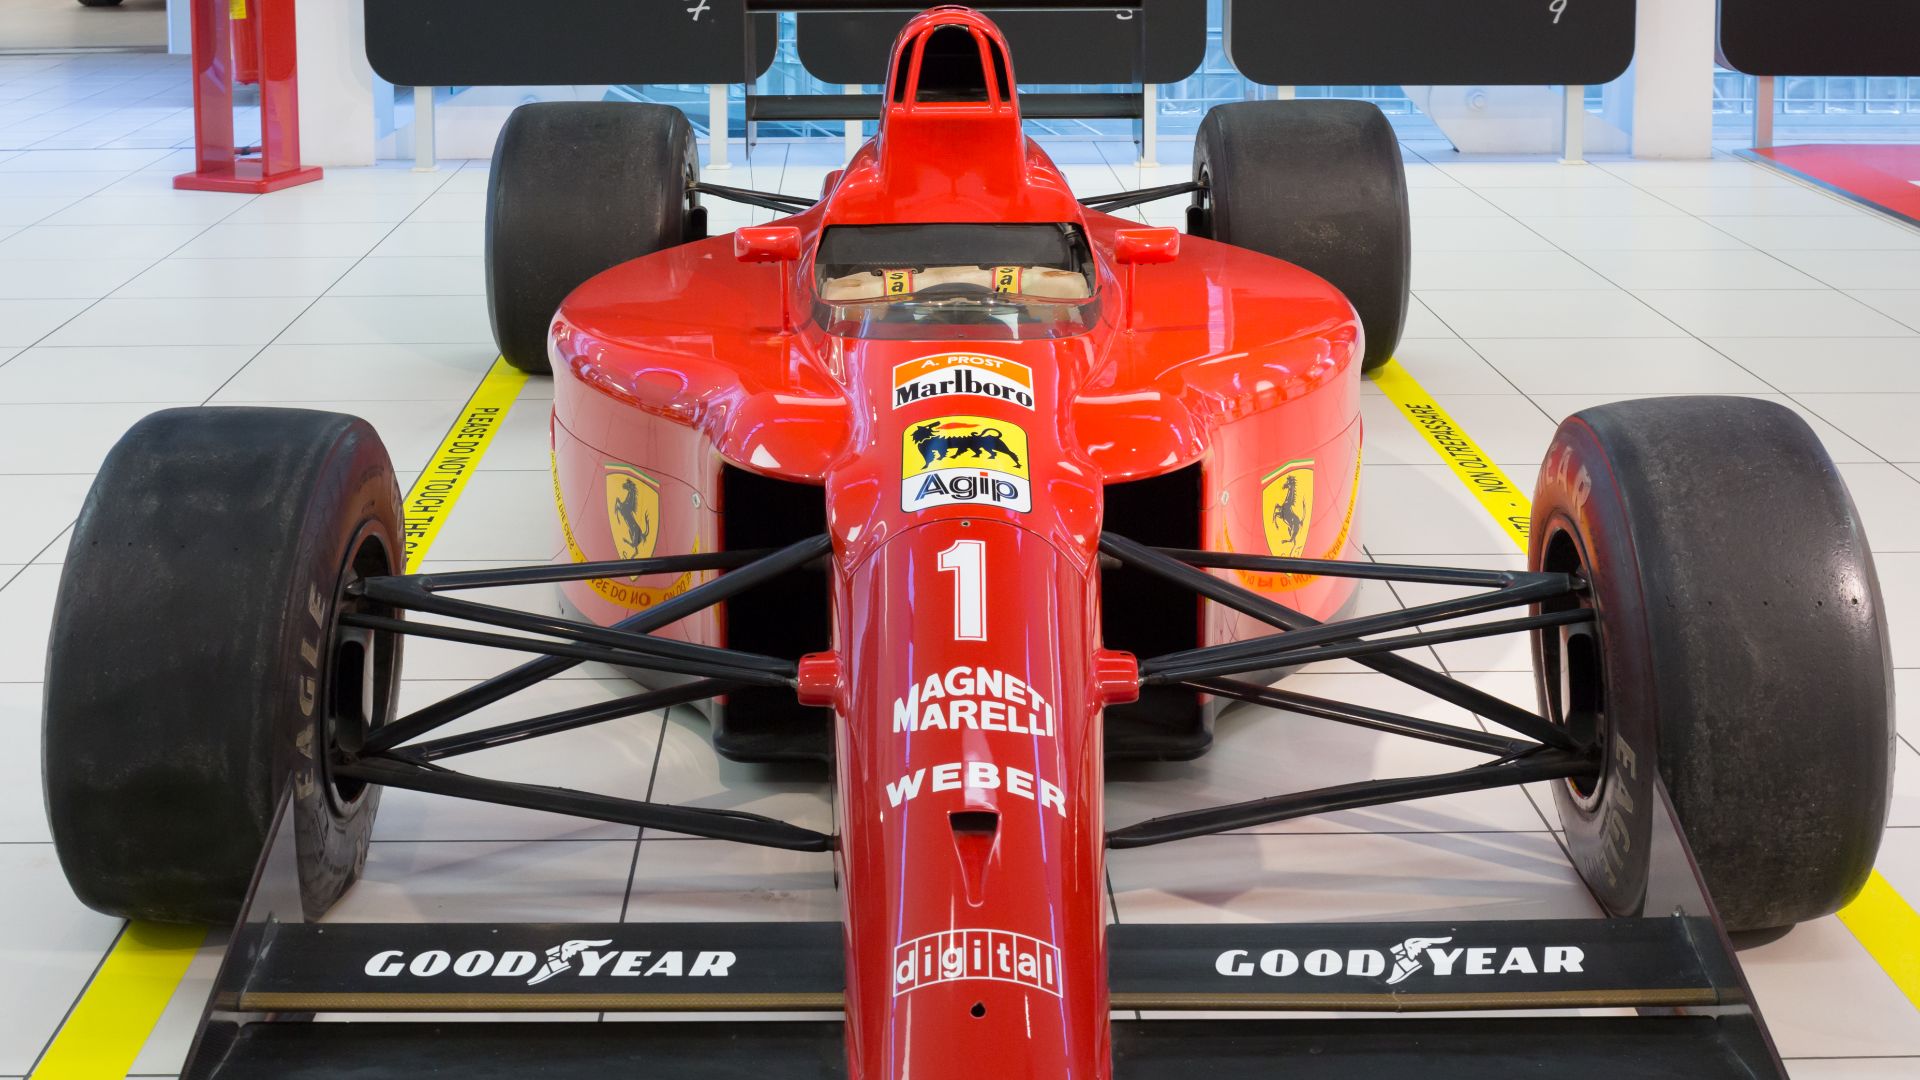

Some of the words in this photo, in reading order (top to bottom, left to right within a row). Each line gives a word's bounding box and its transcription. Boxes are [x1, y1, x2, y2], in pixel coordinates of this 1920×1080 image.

[921, 357, 939, 369] A.
[947, 356, 1003, 369] PROST
[895, 369, 1033, 407] Marlboro
[457, 407, 500, 439] PLEASE
[1405, 403, 1488, 469] OLTREPASSARE
[448, 441, 480, 454] DO
[434, 456, 471, 476] NOT
[1466, 470, 1512, 494] NON
[410, 478, 457, 513] TOUCH
[914, 471, 1019, 502] Agip
[937, 539, 988, 641] 1
[295, 582, 326, 800] EAGLE
[893, 693, 1054, 737] MARELLI
[885, 761, 1067, 818] WEBER
[896, 939, 1053, 985] digital
